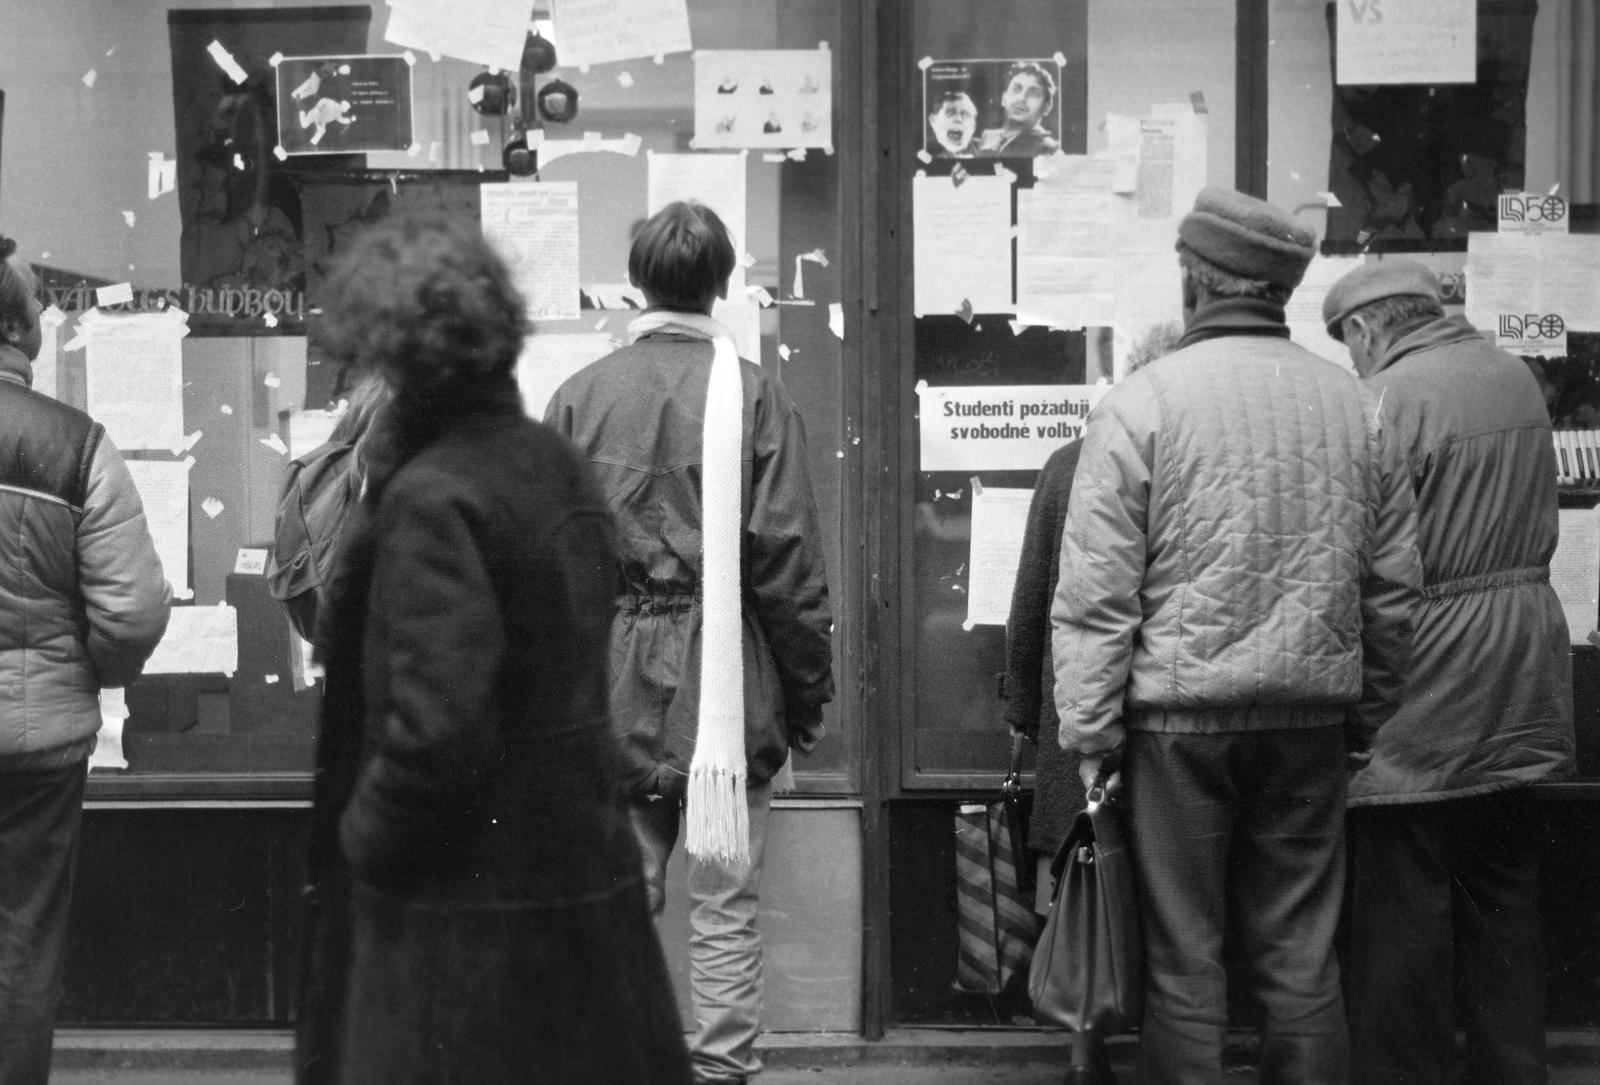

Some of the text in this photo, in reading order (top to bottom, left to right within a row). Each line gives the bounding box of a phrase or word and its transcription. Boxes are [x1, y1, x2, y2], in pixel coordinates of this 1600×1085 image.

[943, 400, 1014, 417] Studenti
[950, 421, 1082, 440] svobodné volby
